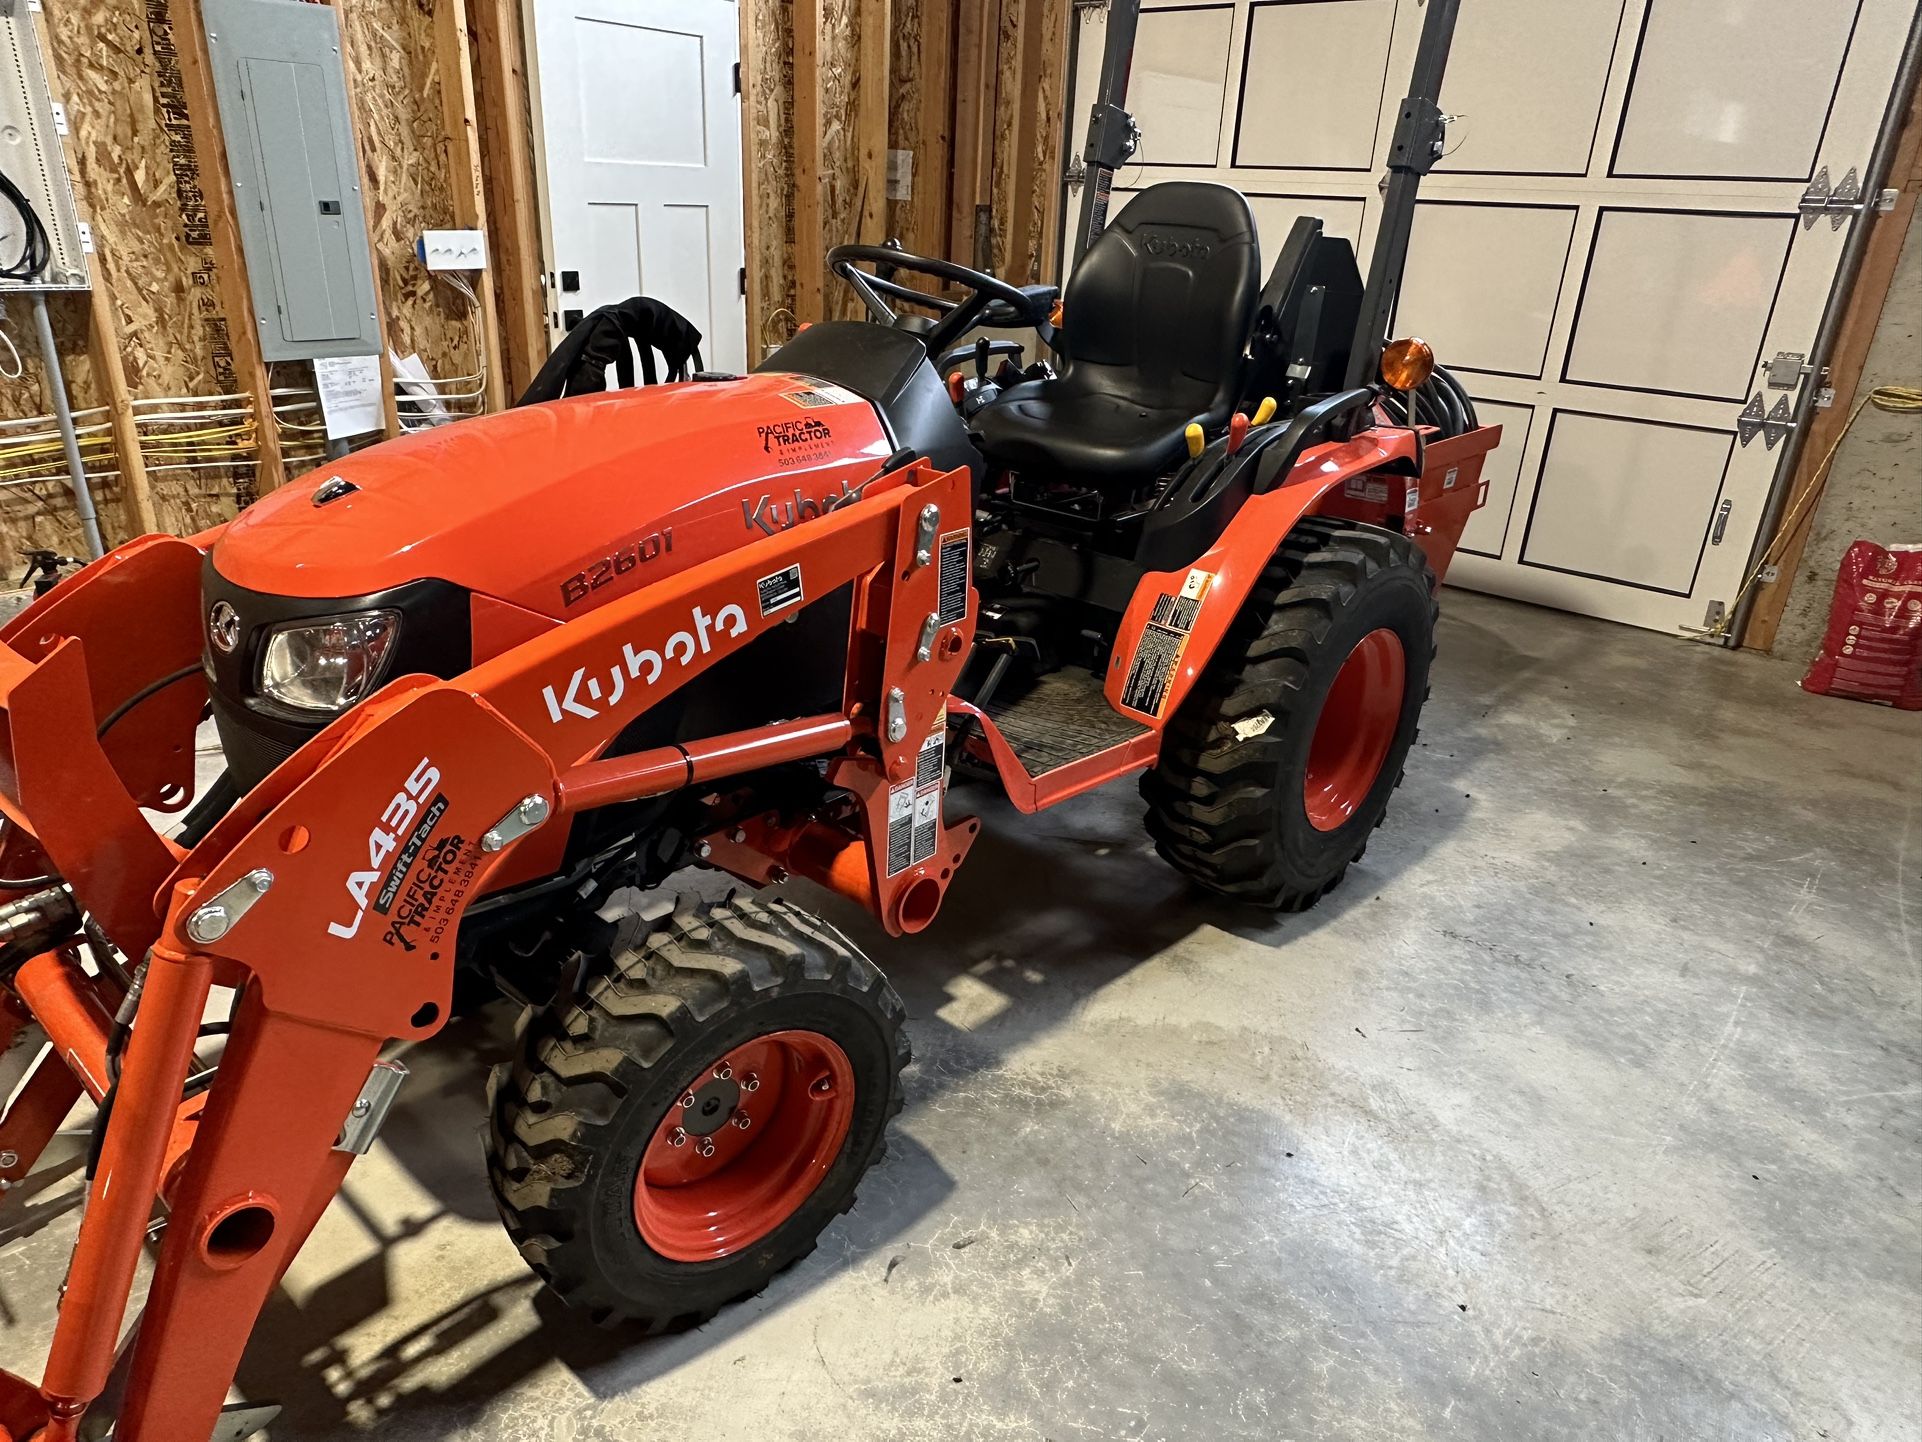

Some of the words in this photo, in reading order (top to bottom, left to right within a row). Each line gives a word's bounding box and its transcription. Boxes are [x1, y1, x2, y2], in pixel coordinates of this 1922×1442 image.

[757, 421, 803, 438] PACIFIC
[774, 428, 831, 447] TRACTOR
[778, 457, 795, 467] 503
[742, 480, 853, 536] Kubot
[559, 526, 673, 608] B2601
[542, 604, 748, 723] Kubota
[327, 756, 441, 939] LA435
[379, 801, 445, 909] Swift-Tach
[406, 834, 465, 928] TRACTOR
[428, 841, 477, 920] IMPLEMENT
[382, 868, 431, 947] PACIFIC
[429, 917, 449, 943] 503
[445, 891, 464, 916] 648
[459, 853, 483, 887] 3841
